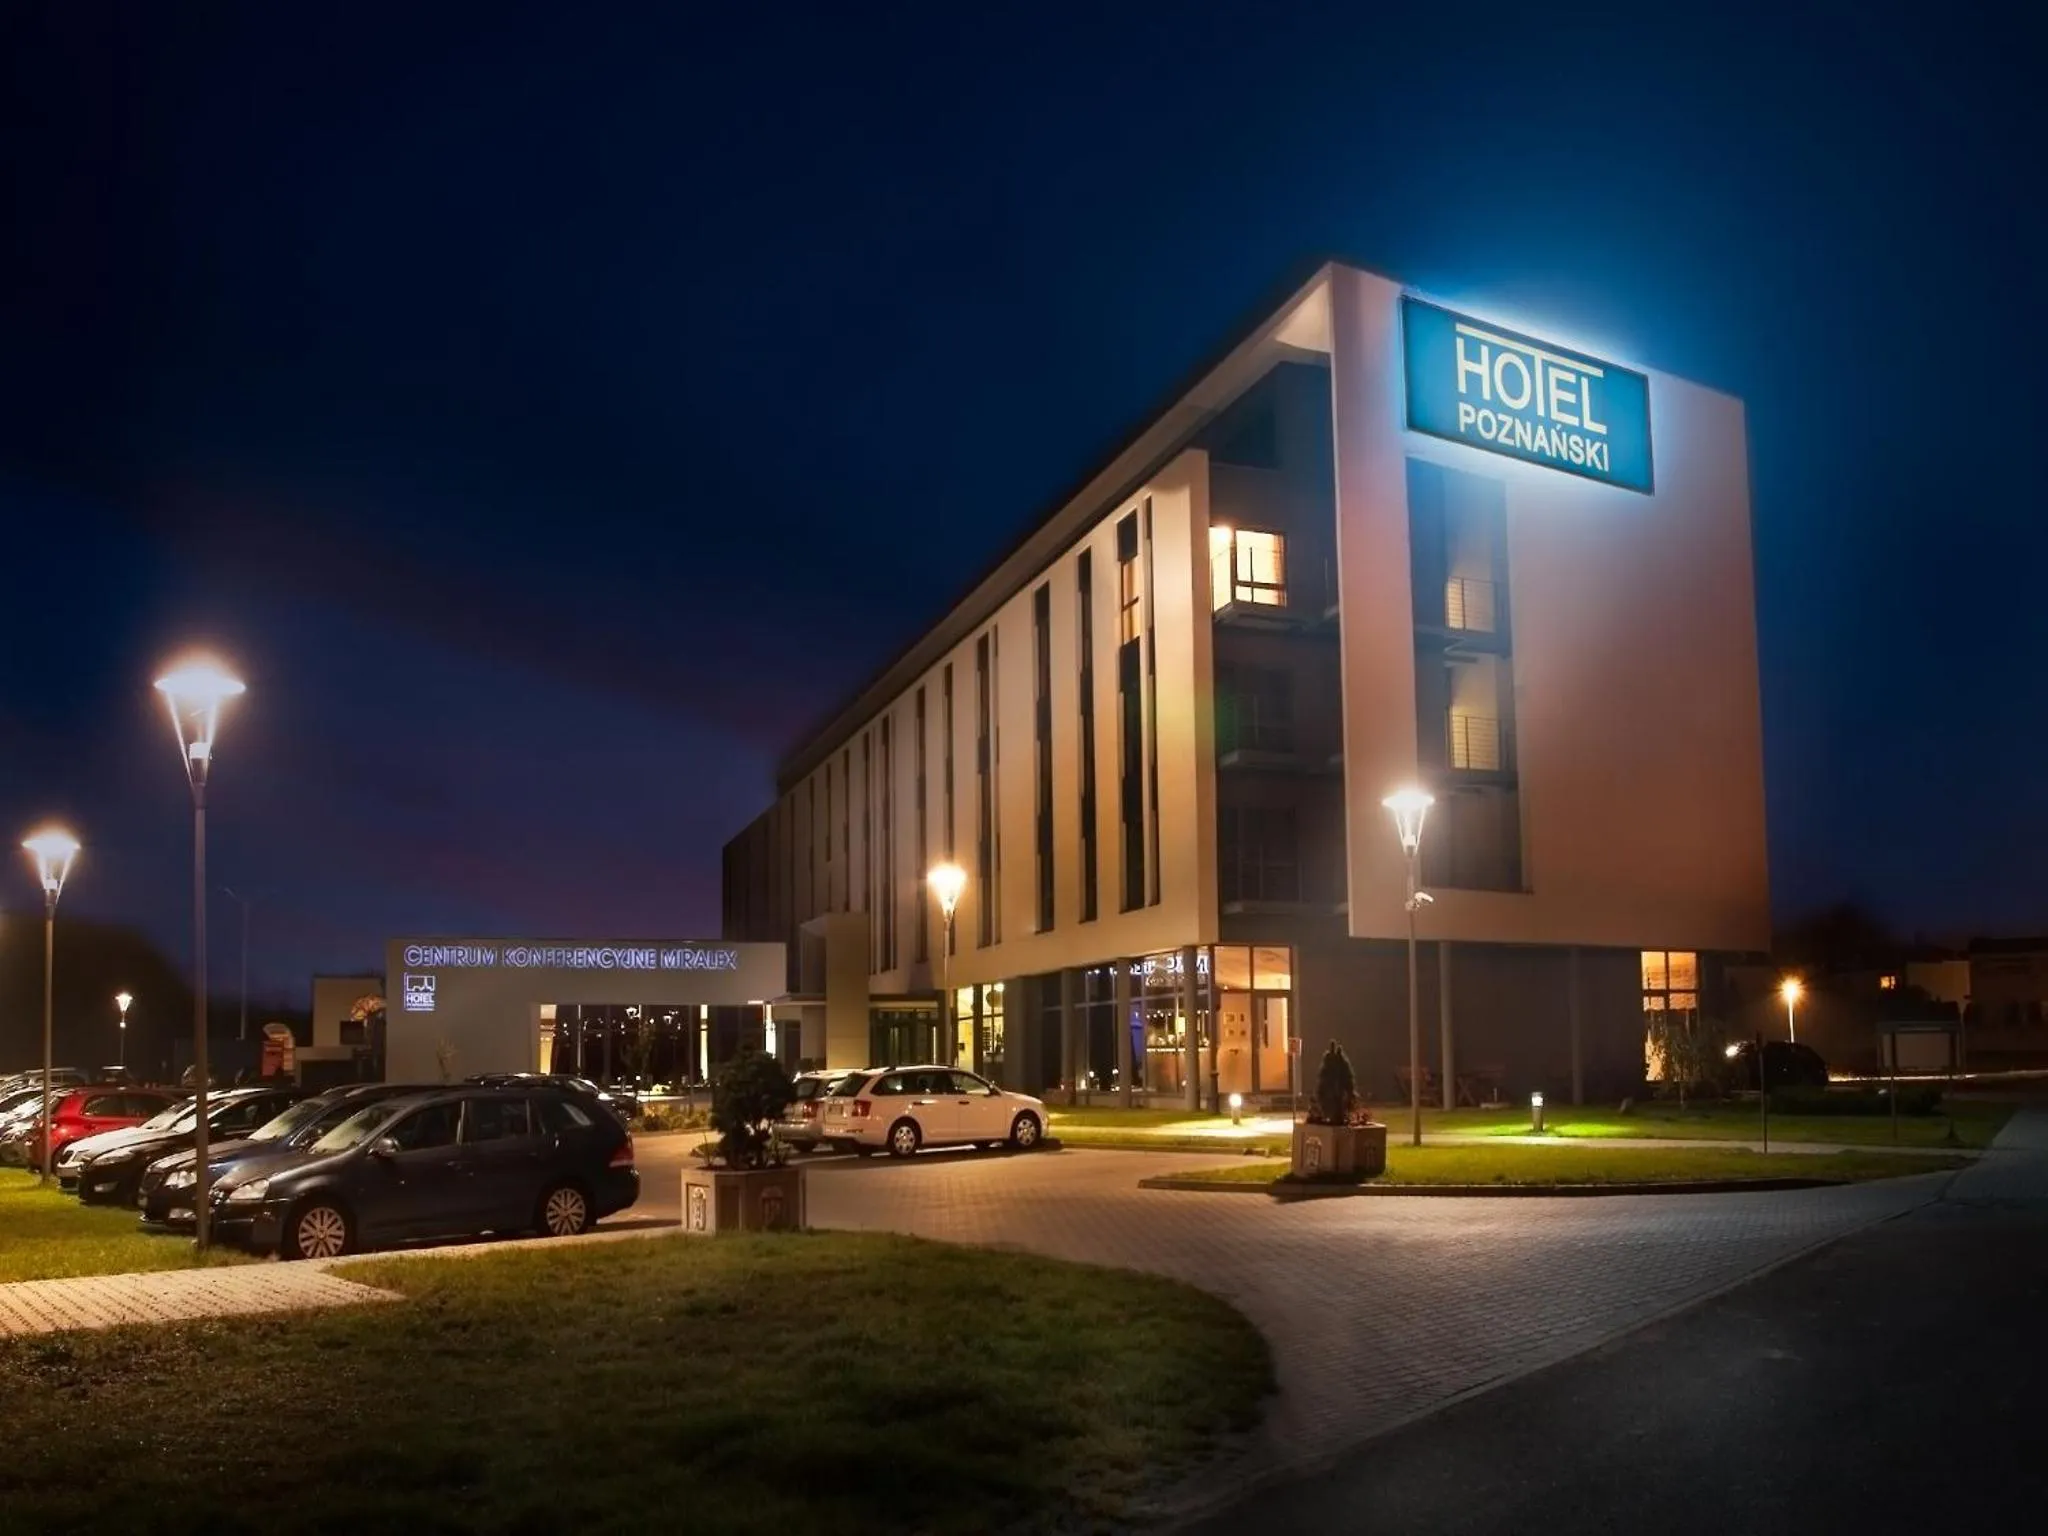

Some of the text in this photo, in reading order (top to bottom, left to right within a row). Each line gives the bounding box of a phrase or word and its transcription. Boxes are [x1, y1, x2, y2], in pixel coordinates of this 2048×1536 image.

[1456, 323, 1607, 434] HOTEL
[1459, 402, 1609, 471] POZNAŃSKI
[404, 945, 737, 969] CENTRUM KONFERENCYJNE MIRALEX
